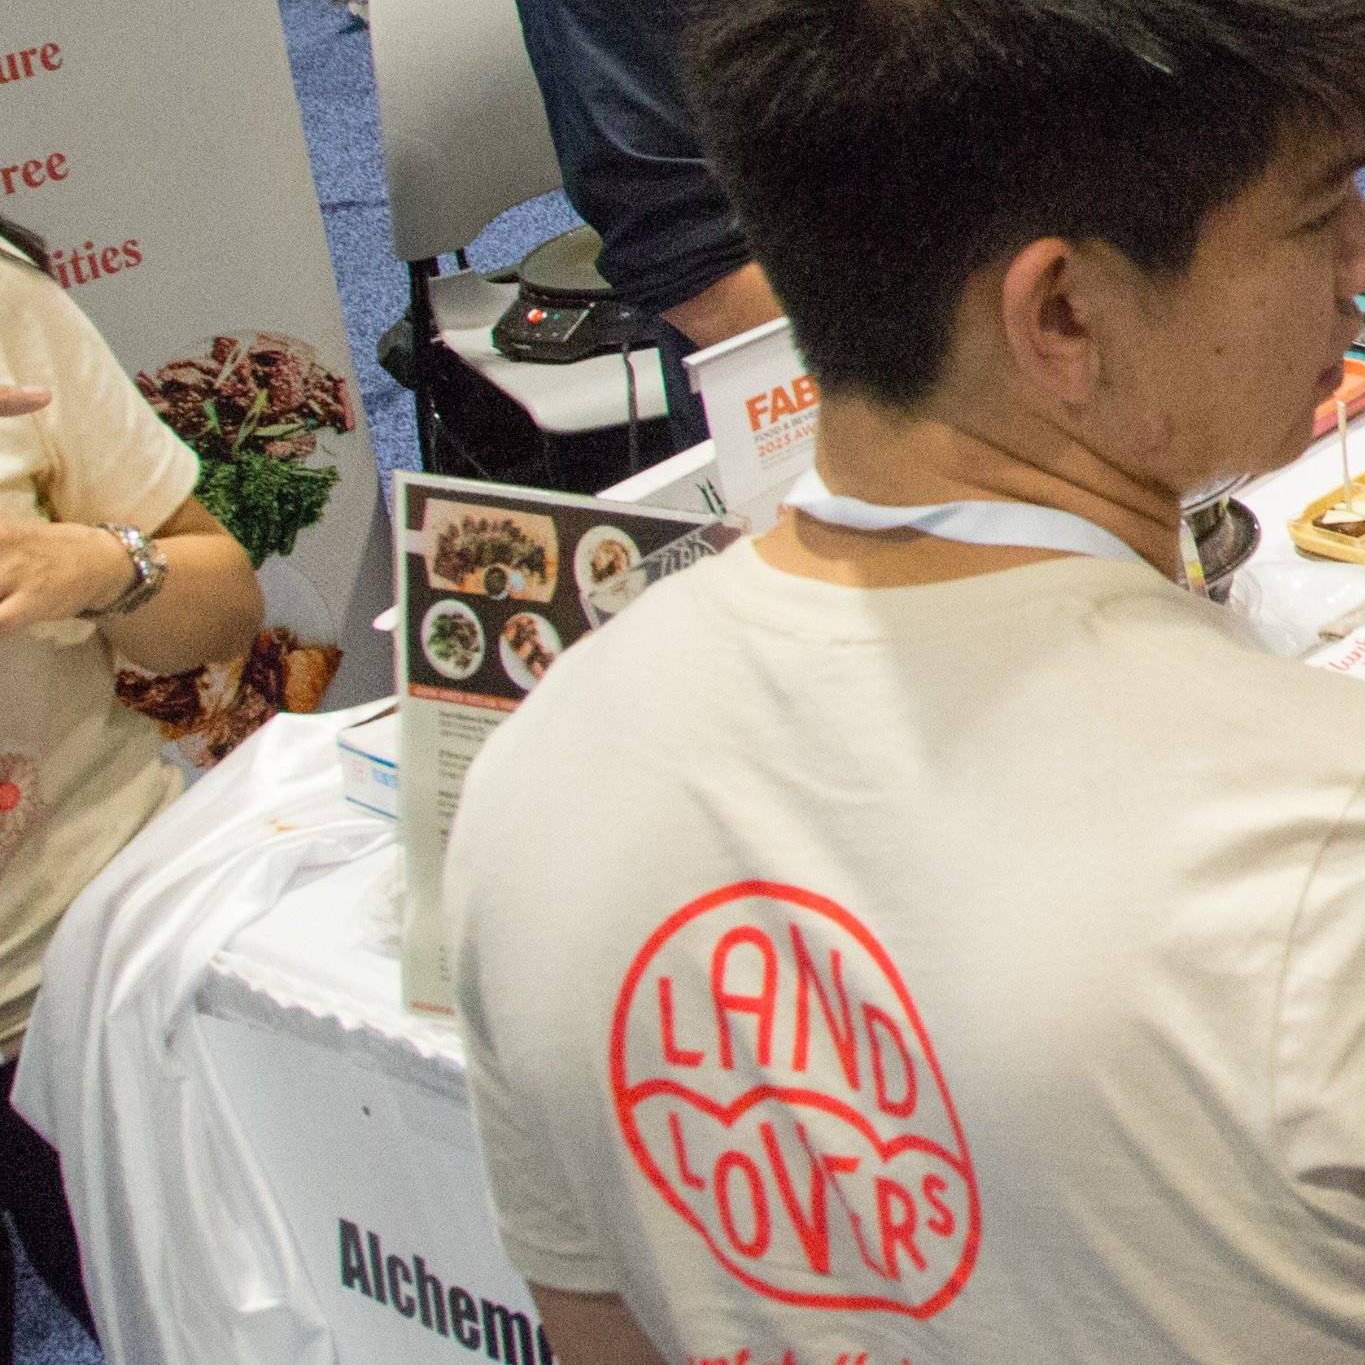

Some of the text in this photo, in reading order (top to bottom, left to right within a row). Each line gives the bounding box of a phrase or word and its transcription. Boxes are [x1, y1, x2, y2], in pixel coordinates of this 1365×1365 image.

[0, 152, 70, 196] ree
[51, 238, 144, 290] ities
[744, 374, 822, 433] FAB
[659, 922, 919, 1118] LAND
[668, 1110, 955, 1282] LOVERS
[339, 1217, 555, 1365] Alchem
